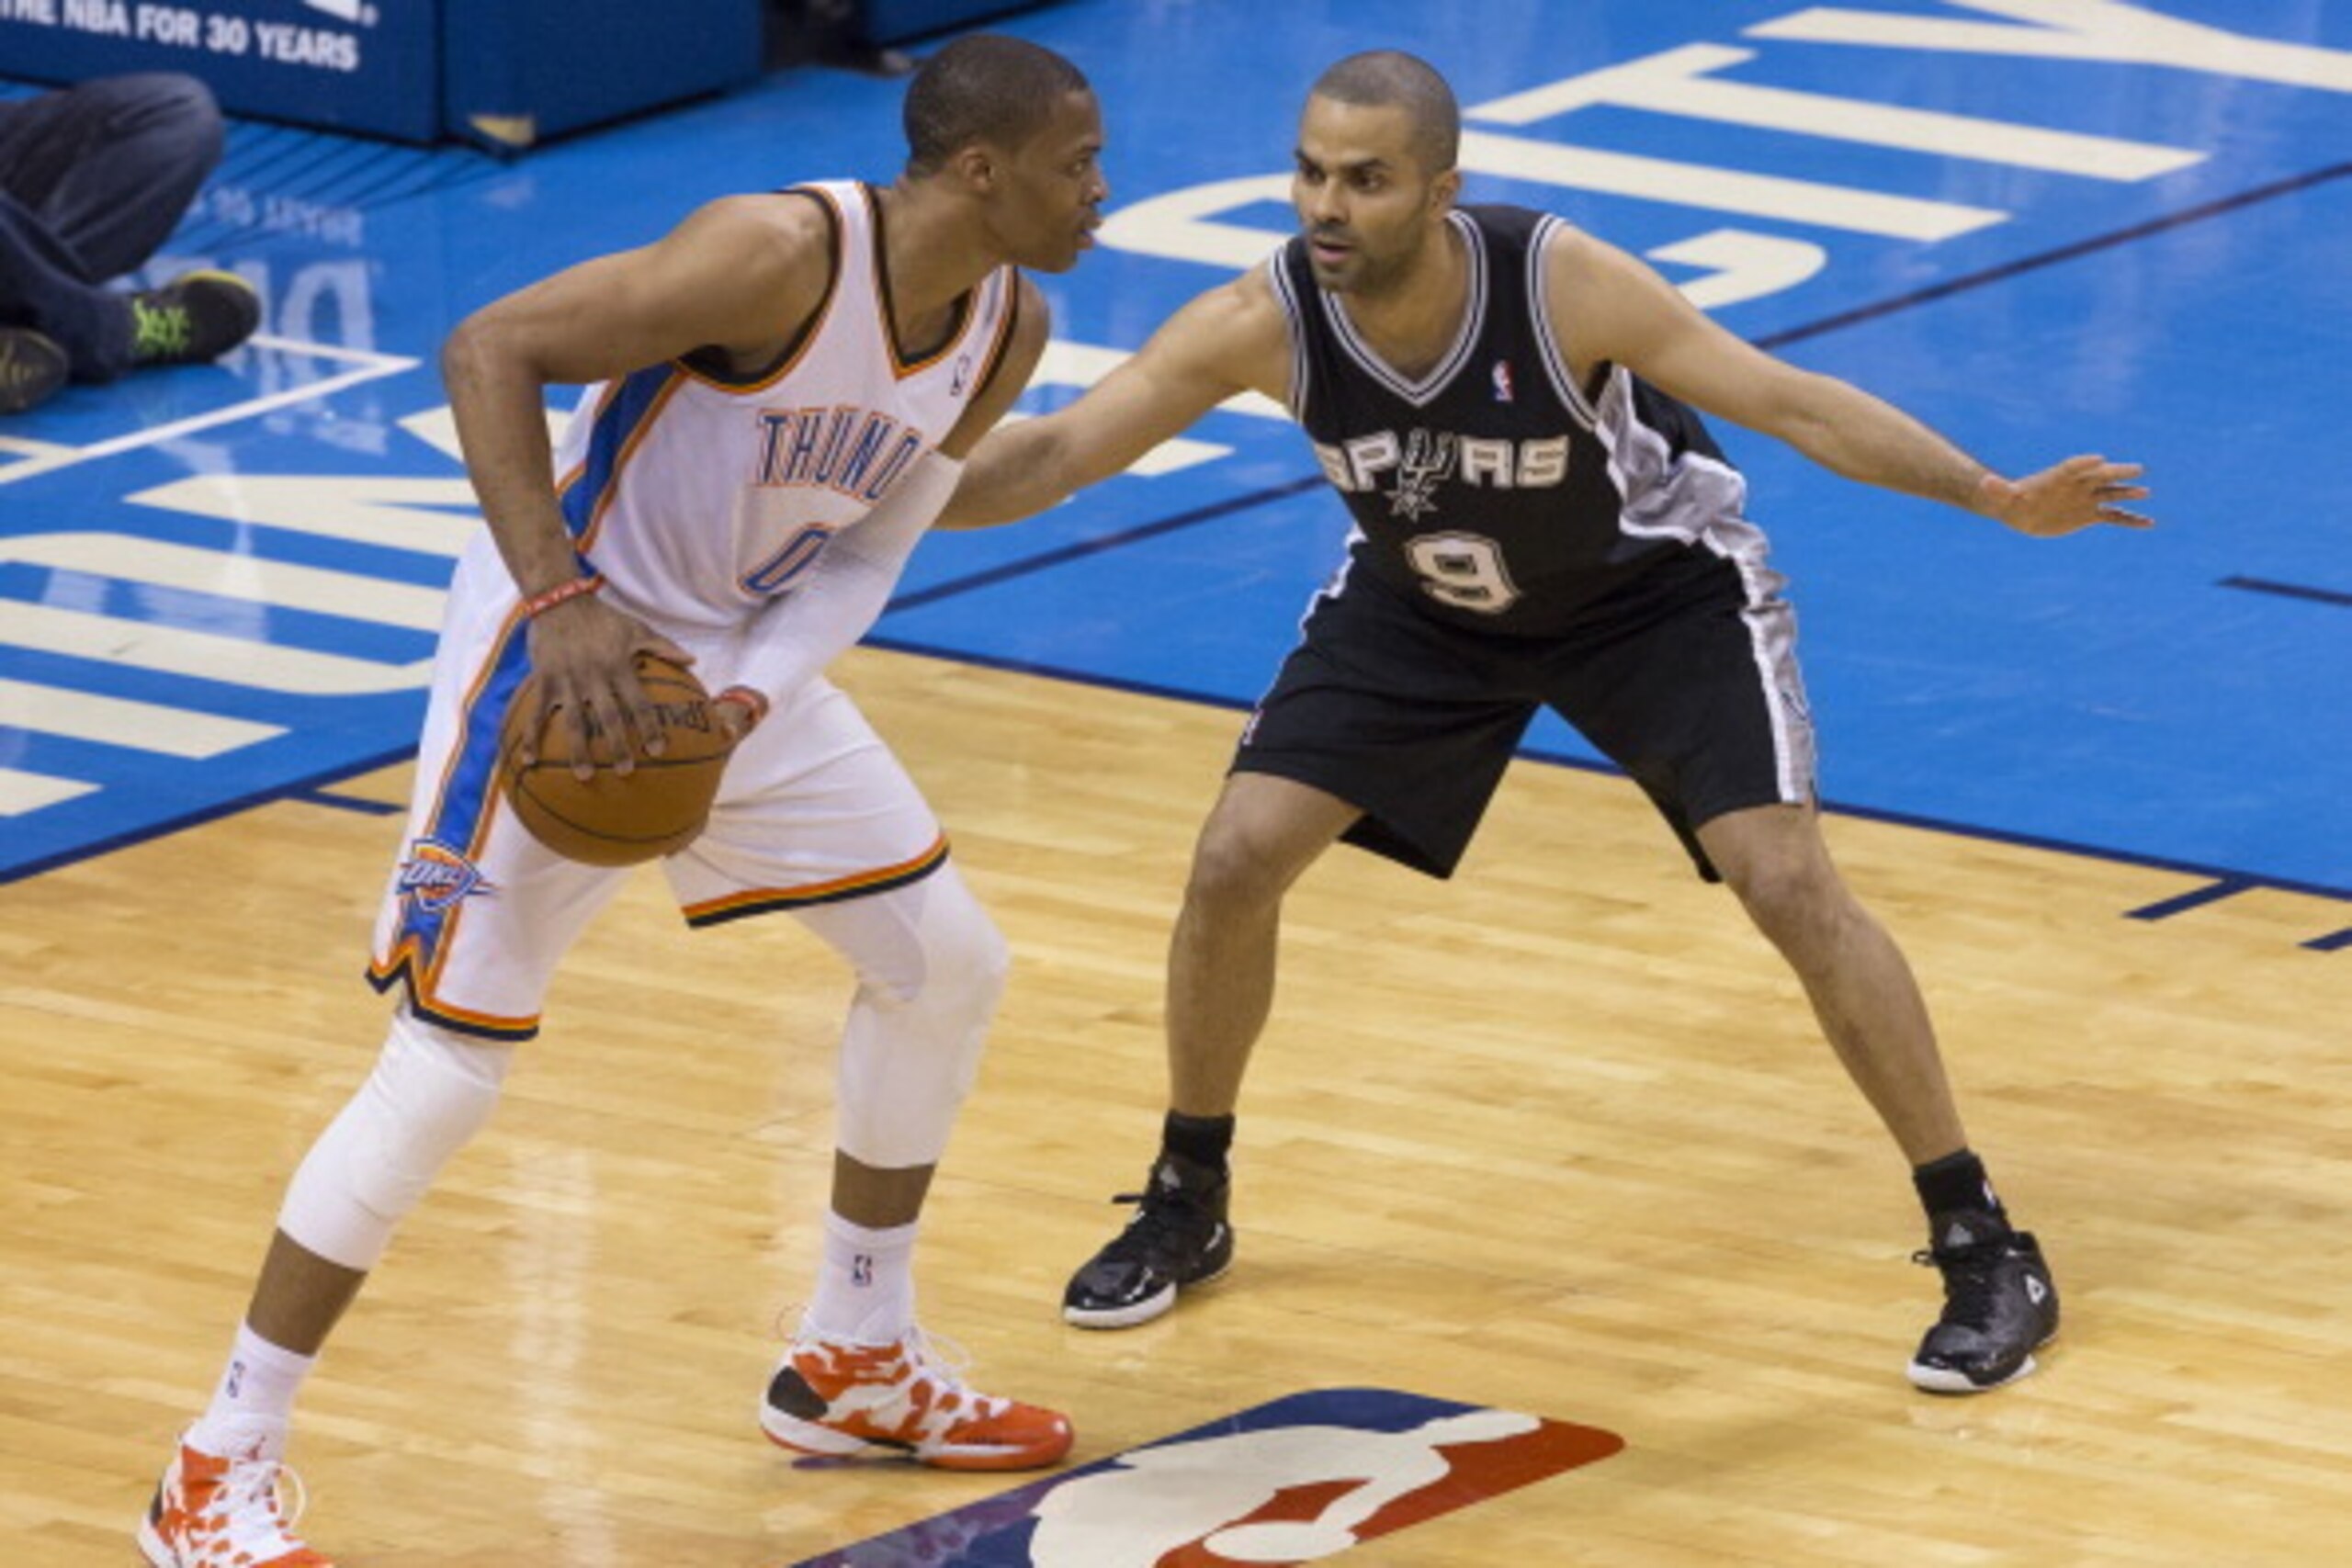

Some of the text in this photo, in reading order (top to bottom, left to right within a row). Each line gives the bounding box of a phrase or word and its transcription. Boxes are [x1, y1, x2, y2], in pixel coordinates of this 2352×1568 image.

[63, 0, 130, 36] NBA
[137, 10, 199, 47] FOR
[207, 16, 250, 53] 30
[256, 23, 359, 71] YEARS
[757, 404, 933, 507] THUND
[740, 522, 832, 595] 0
[1405, 530, 1522, 615] 9
